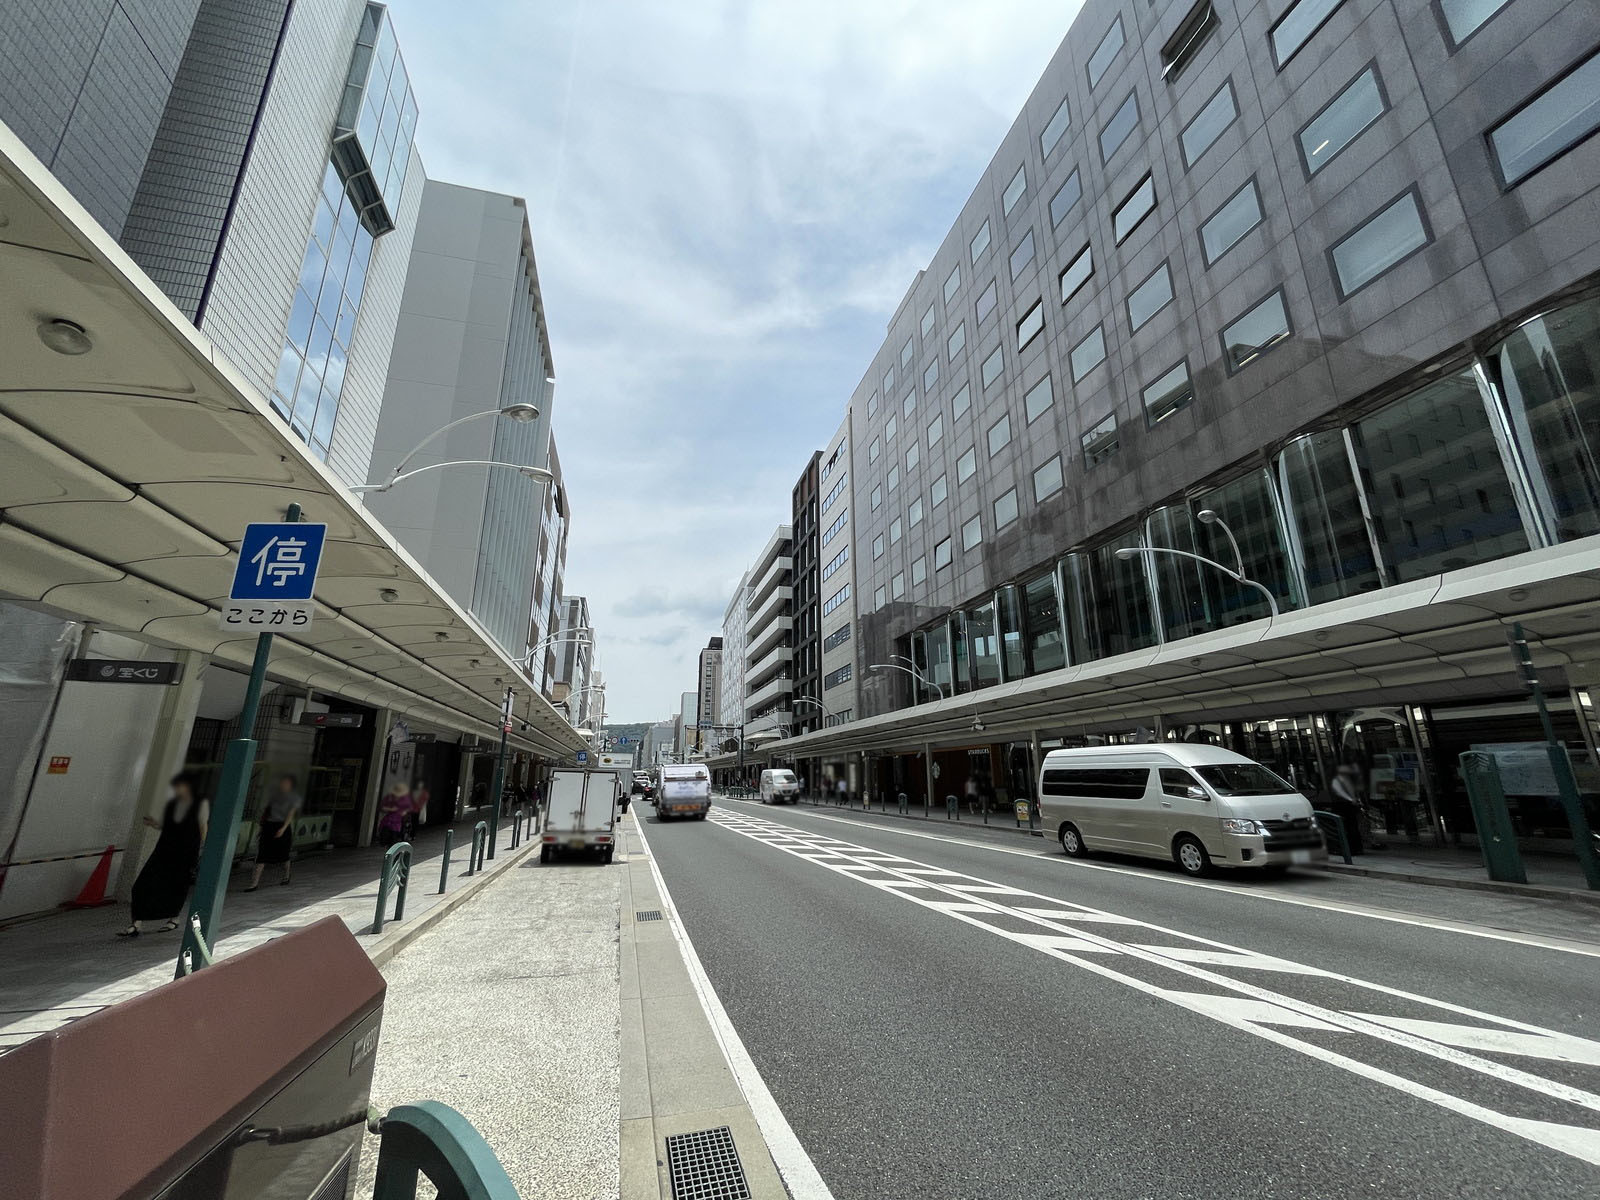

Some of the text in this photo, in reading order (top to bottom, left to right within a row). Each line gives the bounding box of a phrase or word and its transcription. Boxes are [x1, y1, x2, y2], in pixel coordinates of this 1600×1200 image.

[251, 536, 307, 586] 停
[226, 608, 308, 625] ここから
[118, 667, 159, 678] 宝くじ
